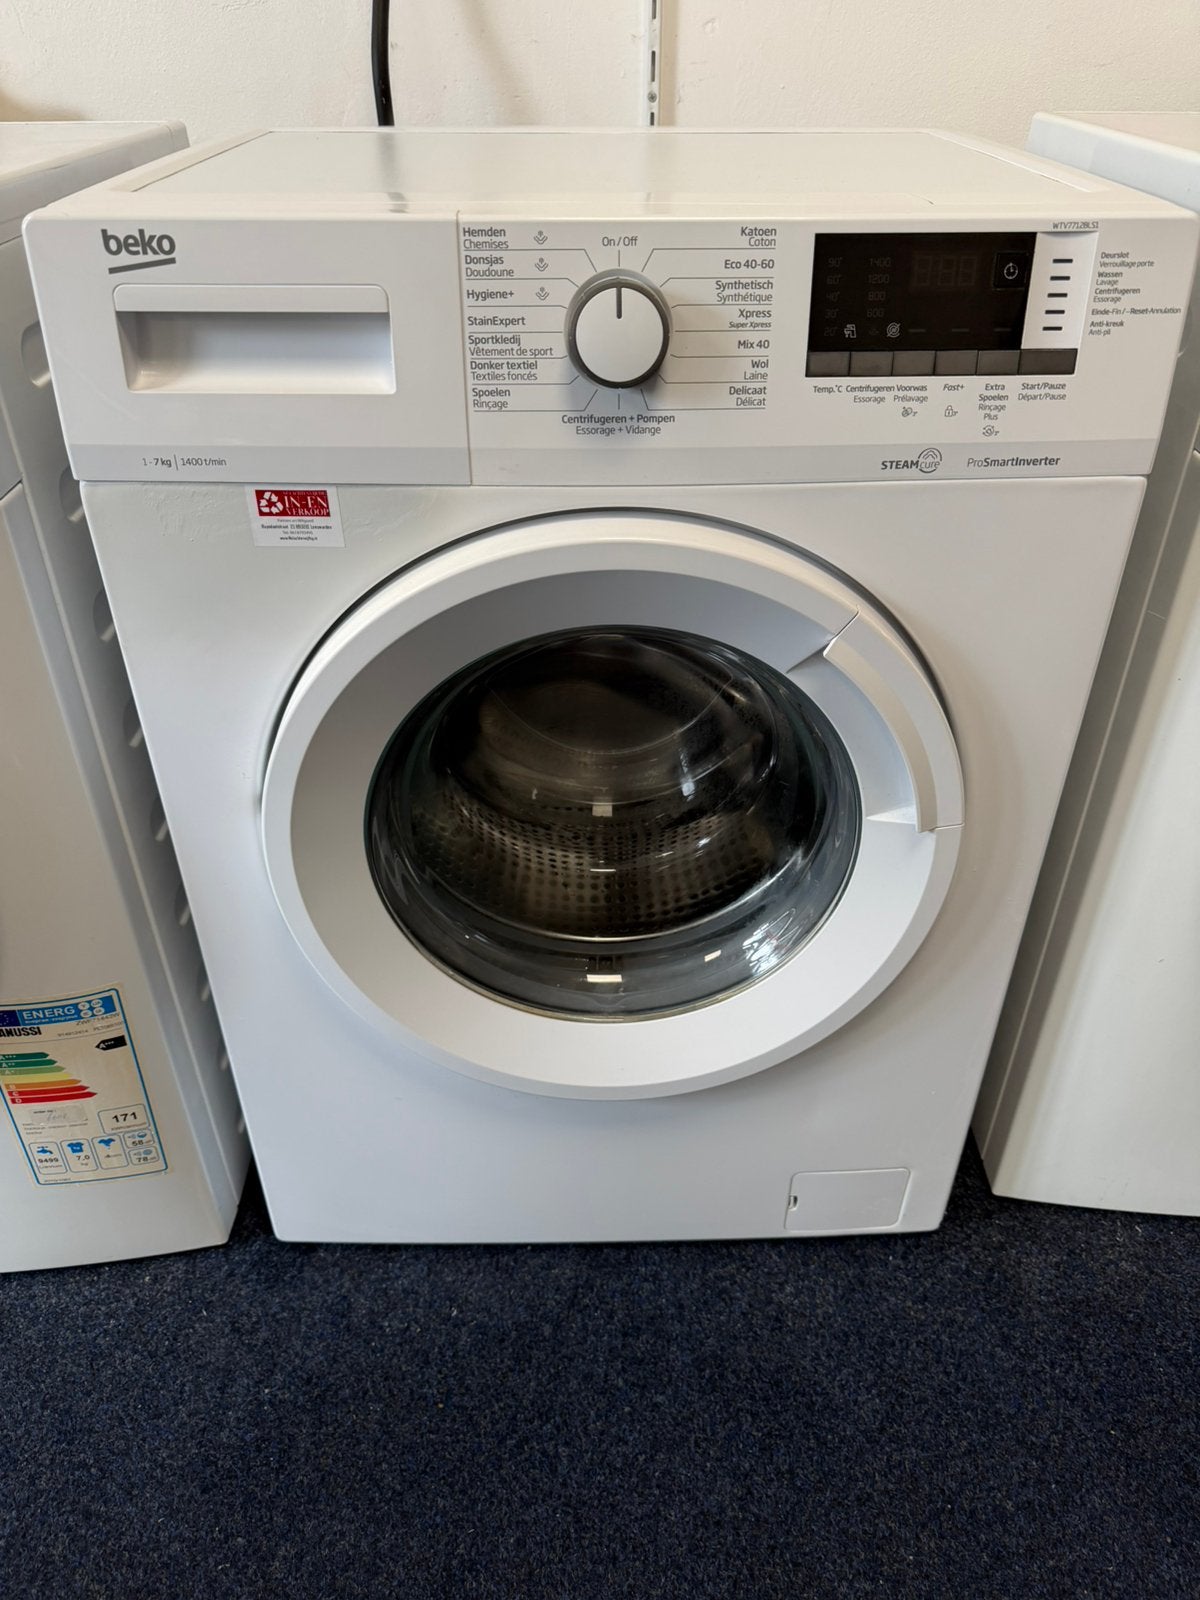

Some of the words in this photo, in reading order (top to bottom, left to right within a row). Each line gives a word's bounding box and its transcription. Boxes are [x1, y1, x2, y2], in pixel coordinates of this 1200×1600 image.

[462, 227, 506, 237] Hemden
[740, 226, 777, 237] Katoen
[101, 228, 176, 256] beko
[463, 239, 509, 249] Chemises
[602, 236, 616, 247] On
[622, 236, 638, 247] Off
[748, 236, 776, 247] Coton
[1101, 251, 1130, 259] Deurslot
[465, 255, 504, 267] Donsjas
[724, 259, 742, 269] Eco
[743, 259, 775, 269] 40-60
[1099, 260, 1136, 269] Verrouillage
[1136, 260, 1155, 268] porte
[465, 267, 515, 278] Doudoune
[715, 280, 773, 293] Synthetisch
[1096, 279, 1119, 287] Lavage
[467, 289, 514, 301] Hygiene+
[1094, 287, 1141, 295] Centrifugeren
[716, 291, 773, 305] Synthétique
[1093, 296, 1122, 304] Essorage
[738, 308, 772, 320] Xpress
[467, 315, 526, 327] StainExpert
[728, 321, 749, 329] Super
[748, 320, 772, 329] Xpress
[1089, 320, 1125, 328] Anti-kreuk
[468, 334, 521, 347] Sportkledij
[737, 340, 755, 349] Mix
[756, 339, 770, 349] 40
[469, 345, 515, 357] Vêtement
[515, 346, 526, 356] de
[526, 347, 554, 358] sport
[470, 360, 505, 370] Donker
[506, 359, 538, 370] textiel
[751, 359, 769, 369] Wol
[471, 371, 506, 381] Textiles
[507, 370, 538, 381] foncés
[744, 370, 768, 381] Laine
[729, 386, 767, 395] Delicaat
[845, 384, 895, 394] Centrifugeren
[896, 384, 928, 392] Voorwas
[943, 383, 965, 391] Fast+
[985, 383, 1006, 391] Extra
[1021, 382, 1067, 391] Start/Pauze
[472, 387, 511, 399] Spoelen
[978, 394, 1009, 402] Spoelen
[1018, 392, 1067, 402] Départ/Pause
[473, 398, 509, 410] Rinçage
[736, 397, 766, 407] Délicat
[853, 395, 886, 404] Essorage
[893, 394, 928, 404] Prélavage
[978, 403, 1006, 412] Rinçage
[561, 414, 627, 426] Centrifugeren
[637, 414, 676, 426] Pompen
[983, 412, 998, 421] Plus
[575, 425, 616, 437] Essorage
[625, 425, 662, 437] Vidange
[160, 457, 172, 468] kg
[181, 457, 203, 466] 1400
[204, 457, 227, 466] t/min
[967, 456, 1061, 468] ProSmartInverter
[286, 508, 329, 516] VERKOOP
[22, 1005, 76, 1020] ENERG
[112, 1111, 137, 1123] 171
